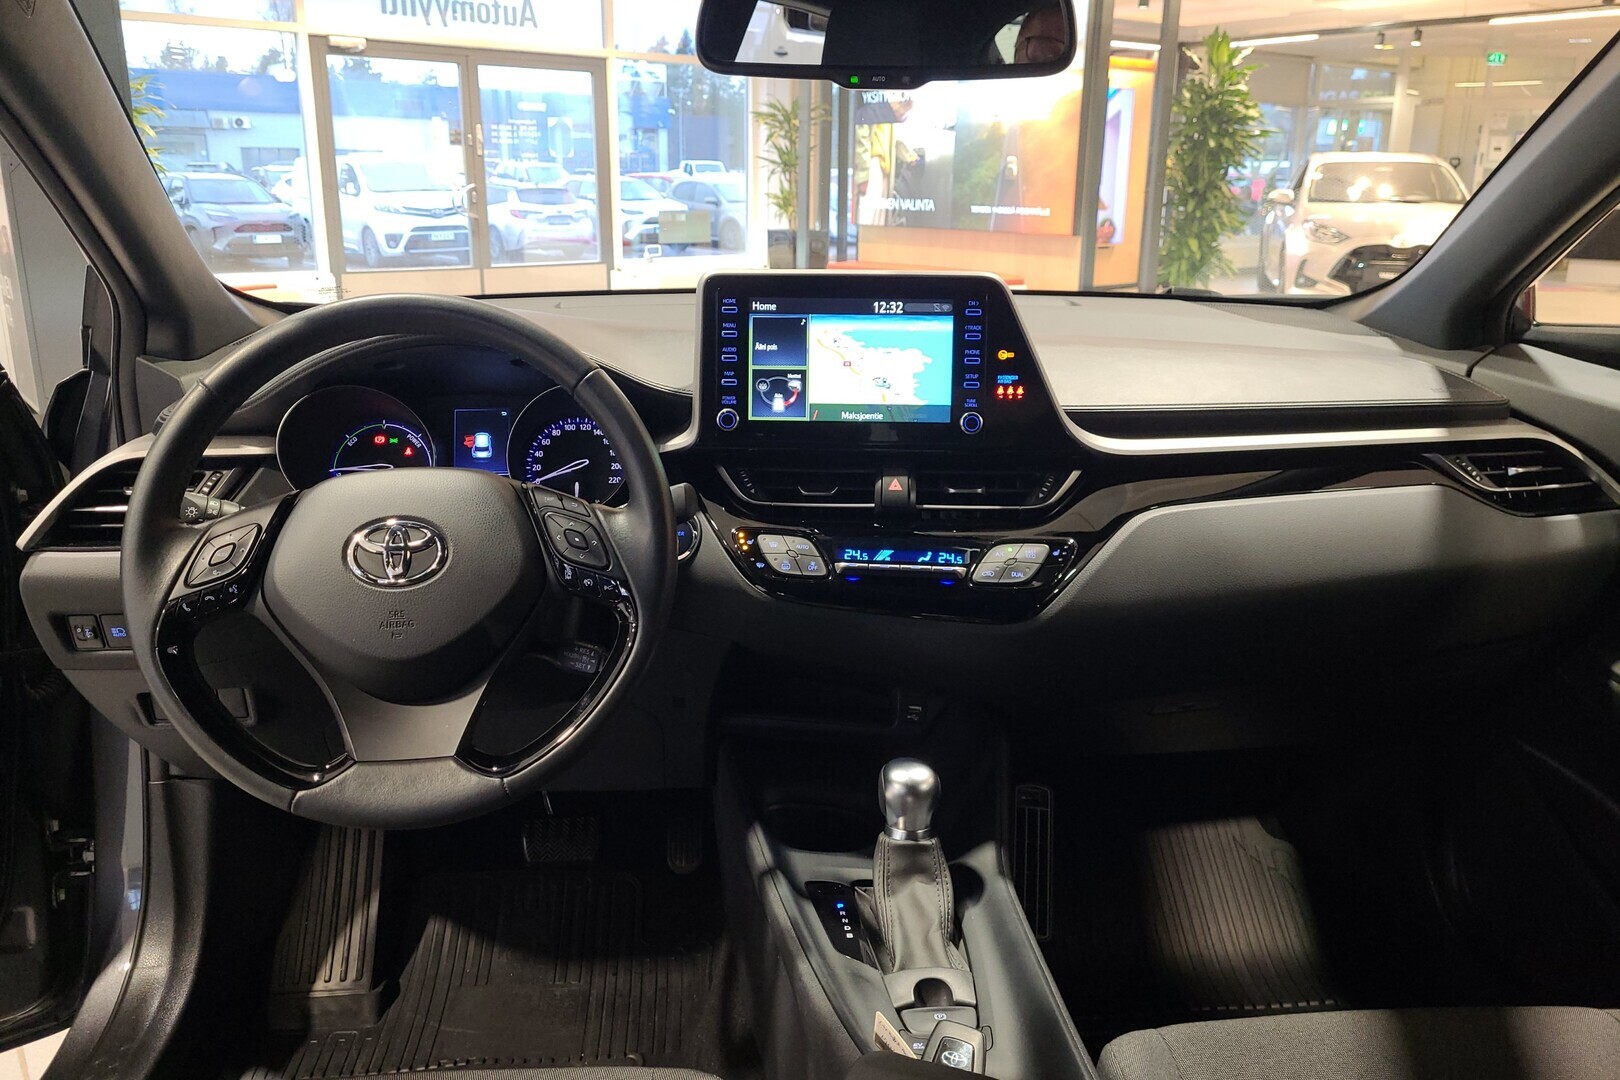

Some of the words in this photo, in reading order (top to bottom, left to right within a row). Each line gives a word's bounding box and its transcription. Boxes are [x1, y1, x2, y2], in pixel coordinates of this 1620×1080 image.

[900, 198, 935, 212] VALINTA
[752, 301, 777, 311] Home
[873, 301, 904, 314] 12:32
[841, 411, 884, 421] Maksjoentie
[347, 437, 358, 447] ECO
[406, 433, 422, 449] POWER
[844, 549, 868, 561] 24.5
[938, 552, 963, 564] 24.5
[379, 620, 415, 630] AIRBAG
